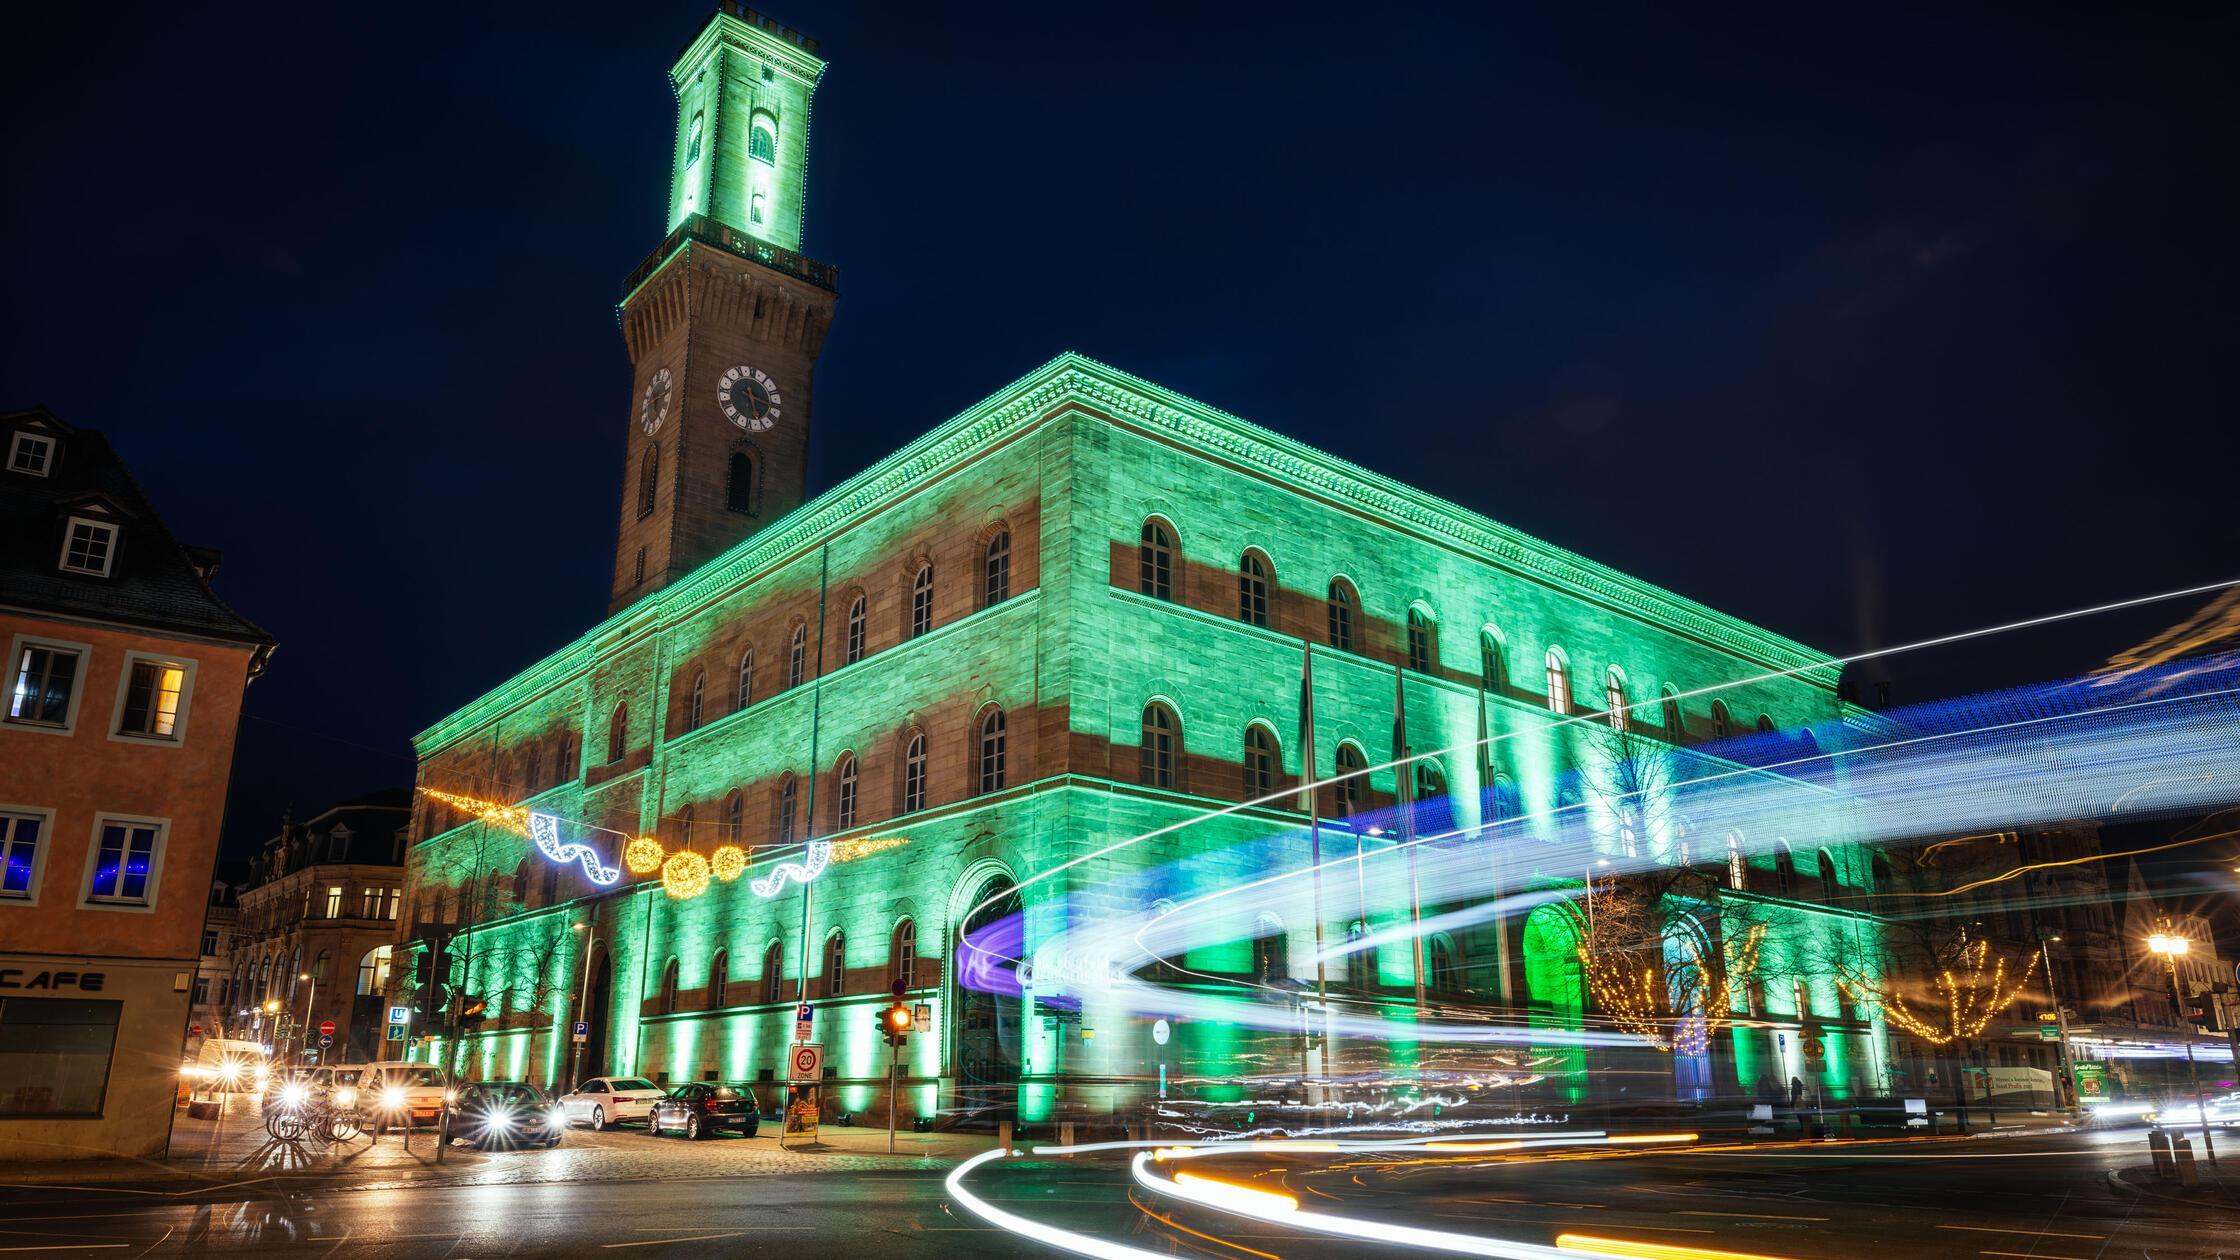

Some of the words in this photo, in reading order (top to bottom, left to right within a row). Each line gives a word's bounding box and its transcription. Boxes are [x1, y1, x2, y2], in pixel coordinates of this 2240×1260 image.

[0, 969, 105, 991] CAFE
[395, 1009, 403, 1018] U
[800, 1006, 810, 1020] P
[576, 1023, 585, 1033] P
[800, 1055, 812, 1066] 20
